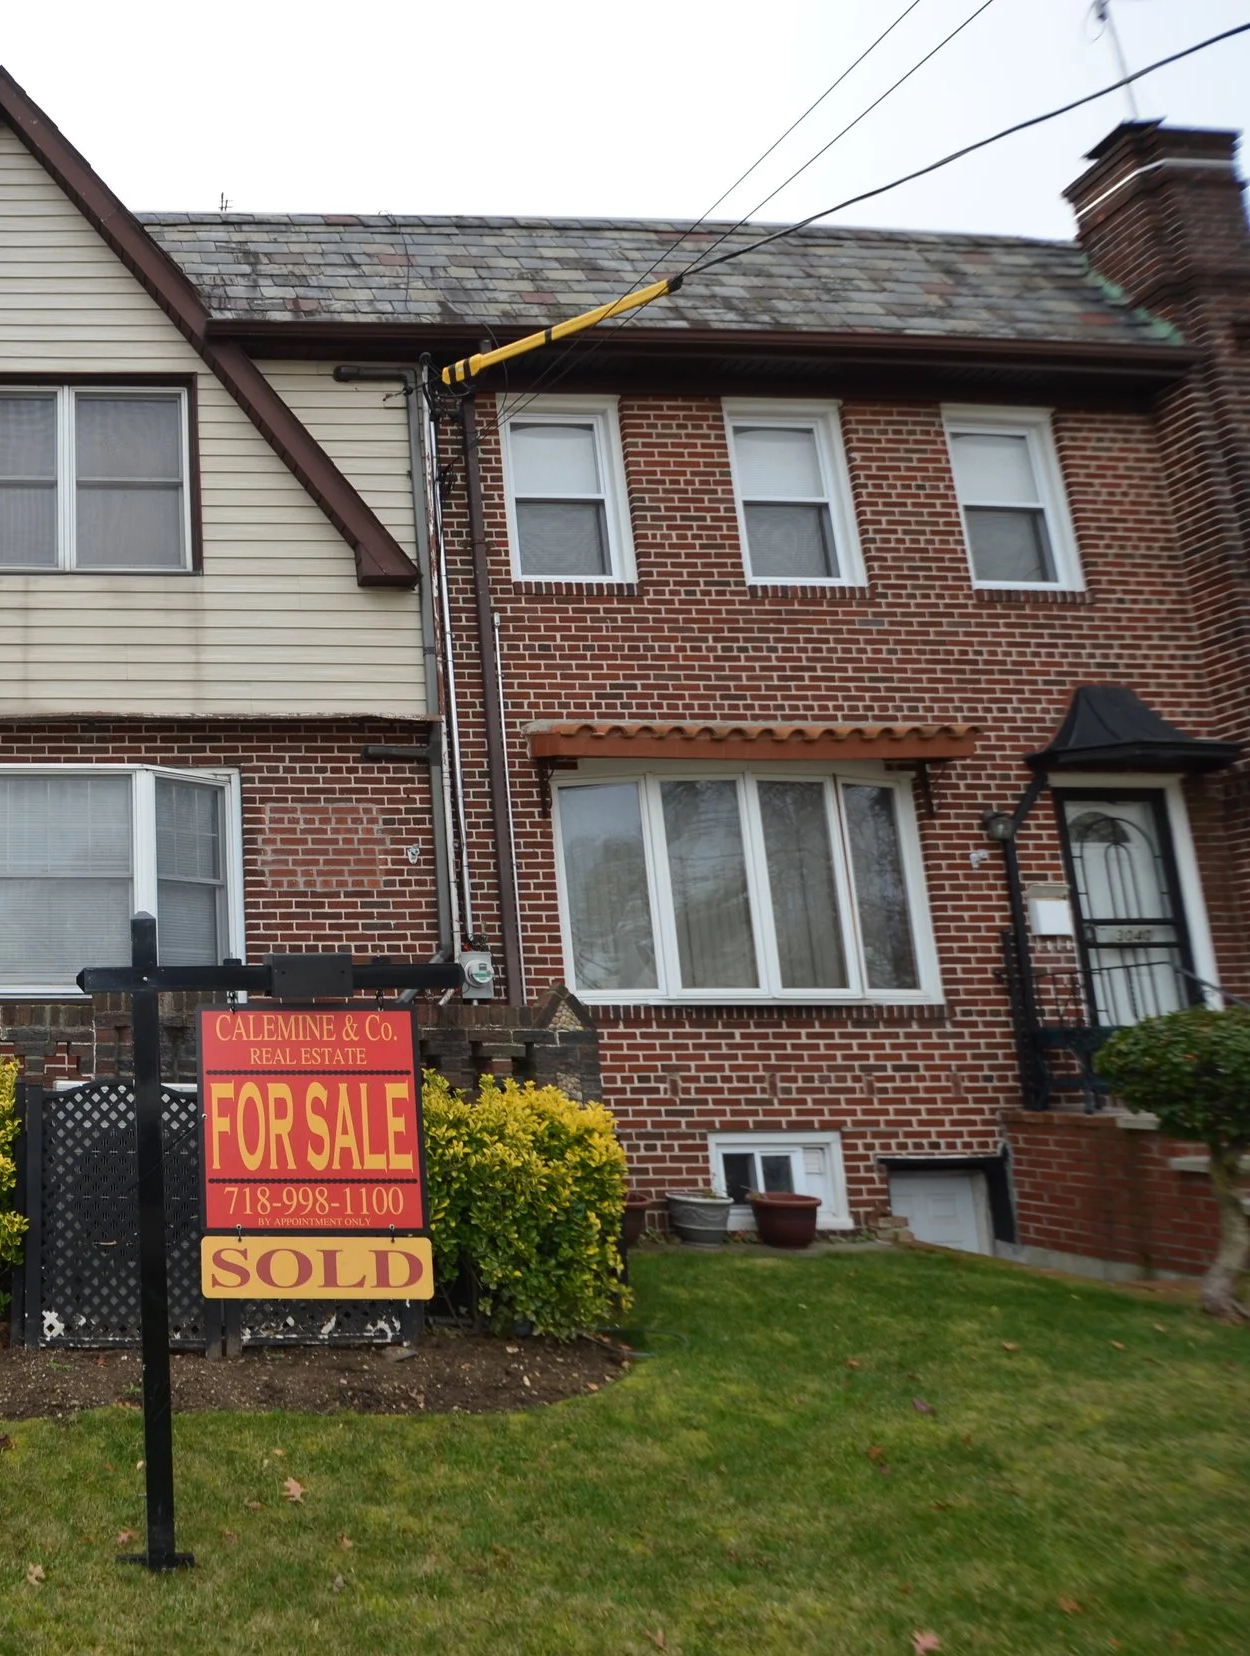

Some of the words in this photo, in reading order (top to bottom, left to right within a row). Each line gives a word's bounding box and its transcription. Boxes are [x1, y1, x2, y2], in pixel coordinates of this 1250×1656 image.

[215, 1014, 336, 1041] CALEMINE
[342, 1014, 360, 1041] &
[365, 1014, 398, 1041] Co.
[249, 1047, 296, 1065] REAL
[301, 1047, 367, 1065] ESTATE
[210, 1079, 297, 1171] FOR
[305, 1079, 414, 1173] SALE
[224, 1186, 404, 1216] 718-998-1100
[258, 1217, 272, 1226] BY
[274, 1217, 343, 1226] APPOINTMENT
[344, 1217, 371, 1226] ONLY
[211, 1247, 424, 1289] SOLD
